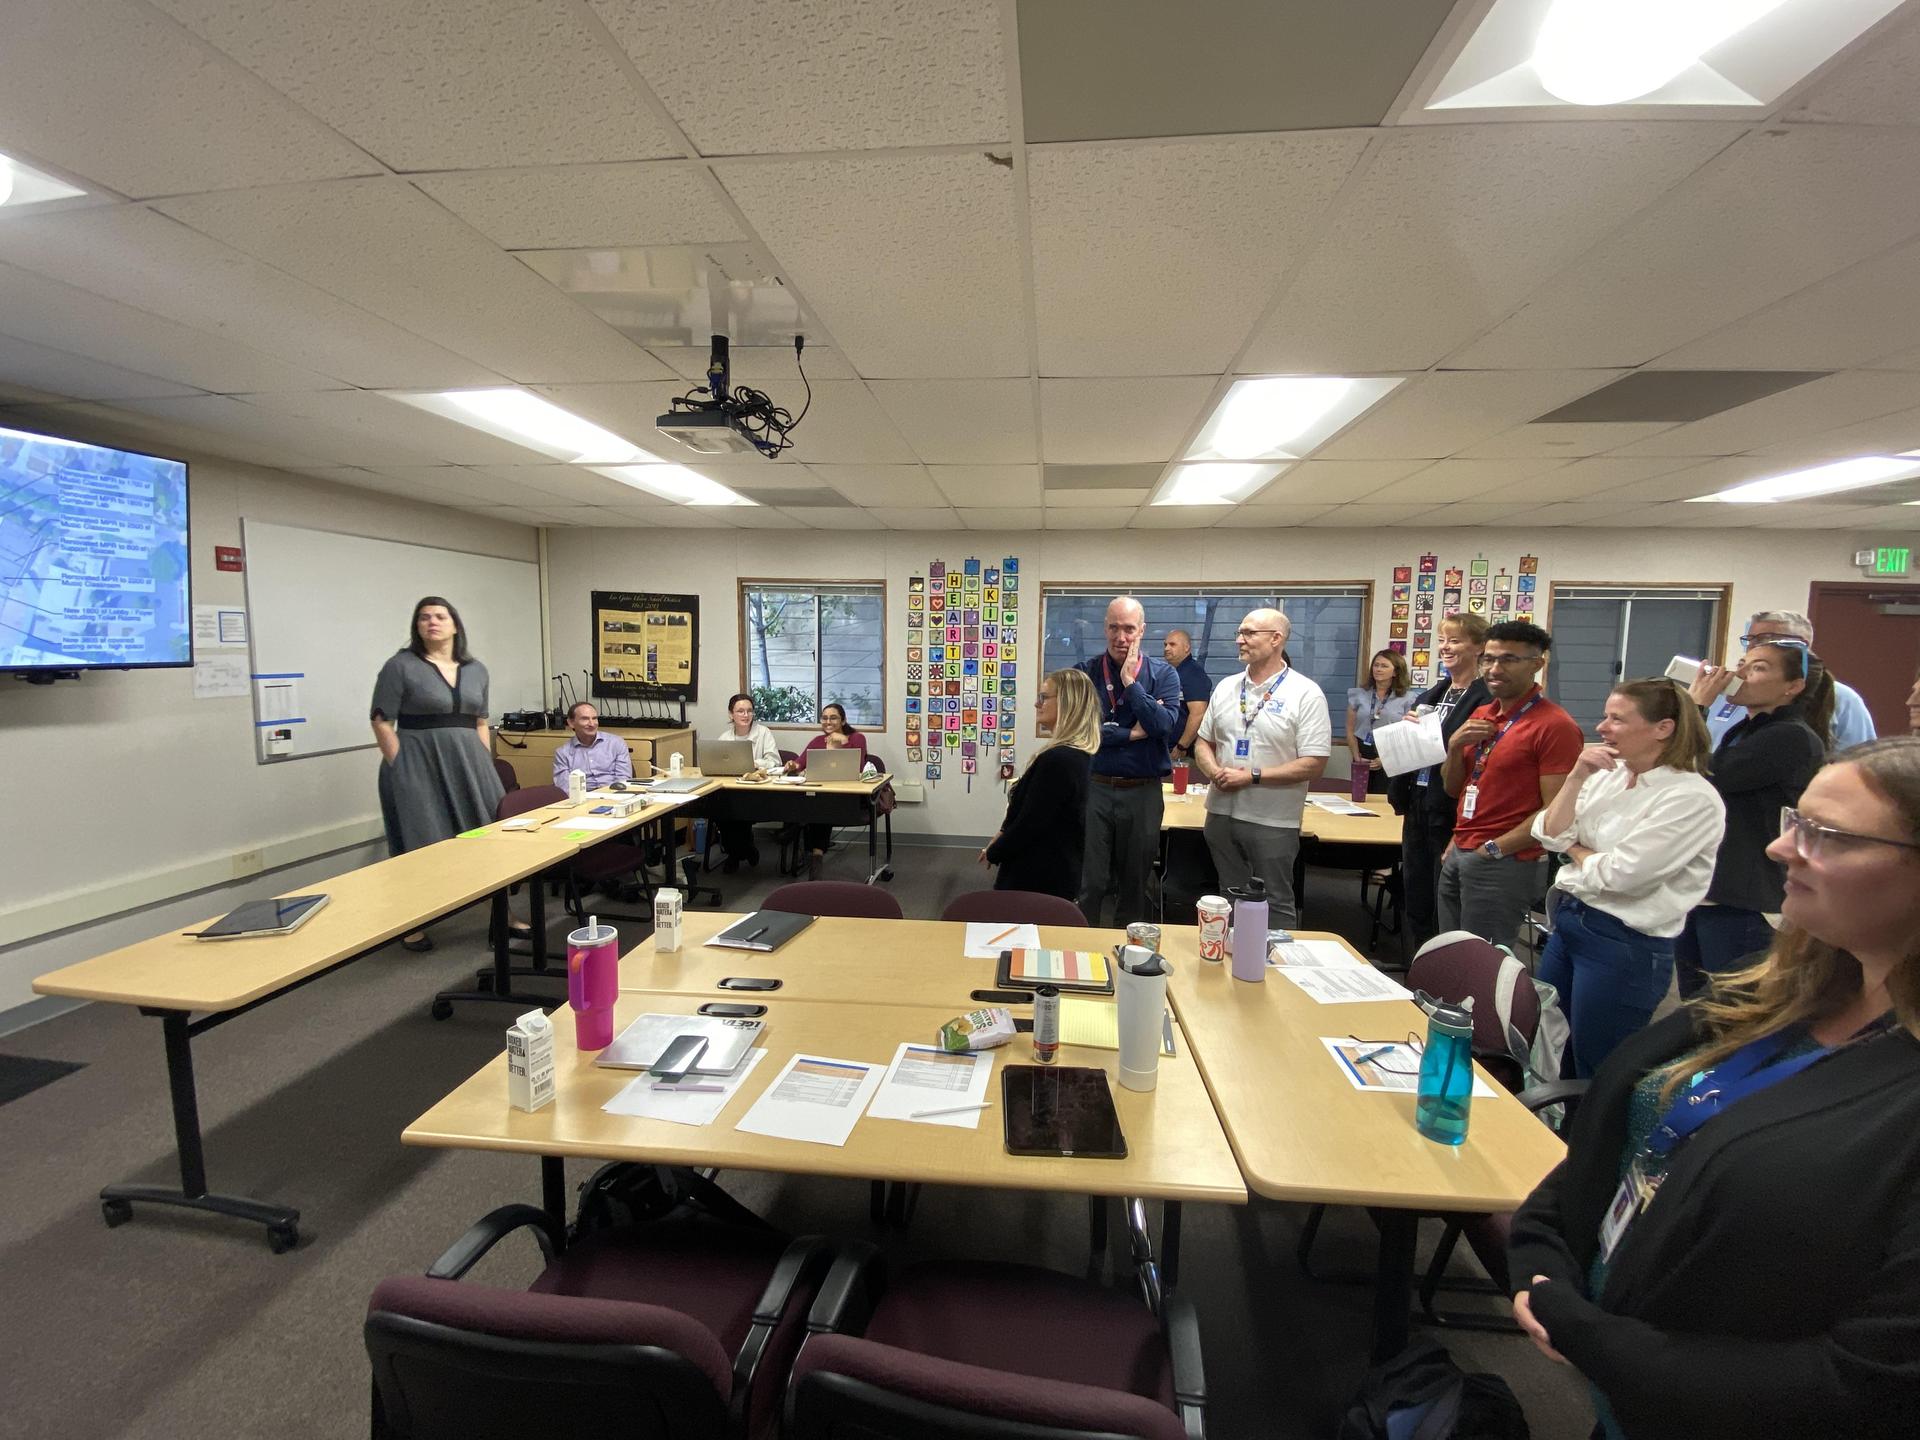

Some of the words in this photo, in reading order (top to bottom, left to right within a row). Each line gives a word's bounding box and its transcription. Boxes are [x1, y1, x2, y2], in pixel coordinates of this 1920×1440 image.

[60, 474, 80, 483] Music
[83, 479, 120, 489] Classroom
[60, 490, 98, 500] Renovated
[60, 496, 94, 506] Computer
[60, 514, 98, 524] Renovated
[61, 520, 82, 528] Music
[83, 524, 120, 532] Classroom
[60, 537, 98, 547] Renovated
[61, 544, 88, 552] Support
[90, 546, 116, 555] Spaces
[1876, 548, 1909, 572] EXIT
[62, 573, 100, 582] Renovated
[948, 575, 959, 676] HEARTS
[985, 589, 996, 727] KINDNESS
[948, 700, 958, 728] OF
[970, 1010, 986, 1030] CHIPS
